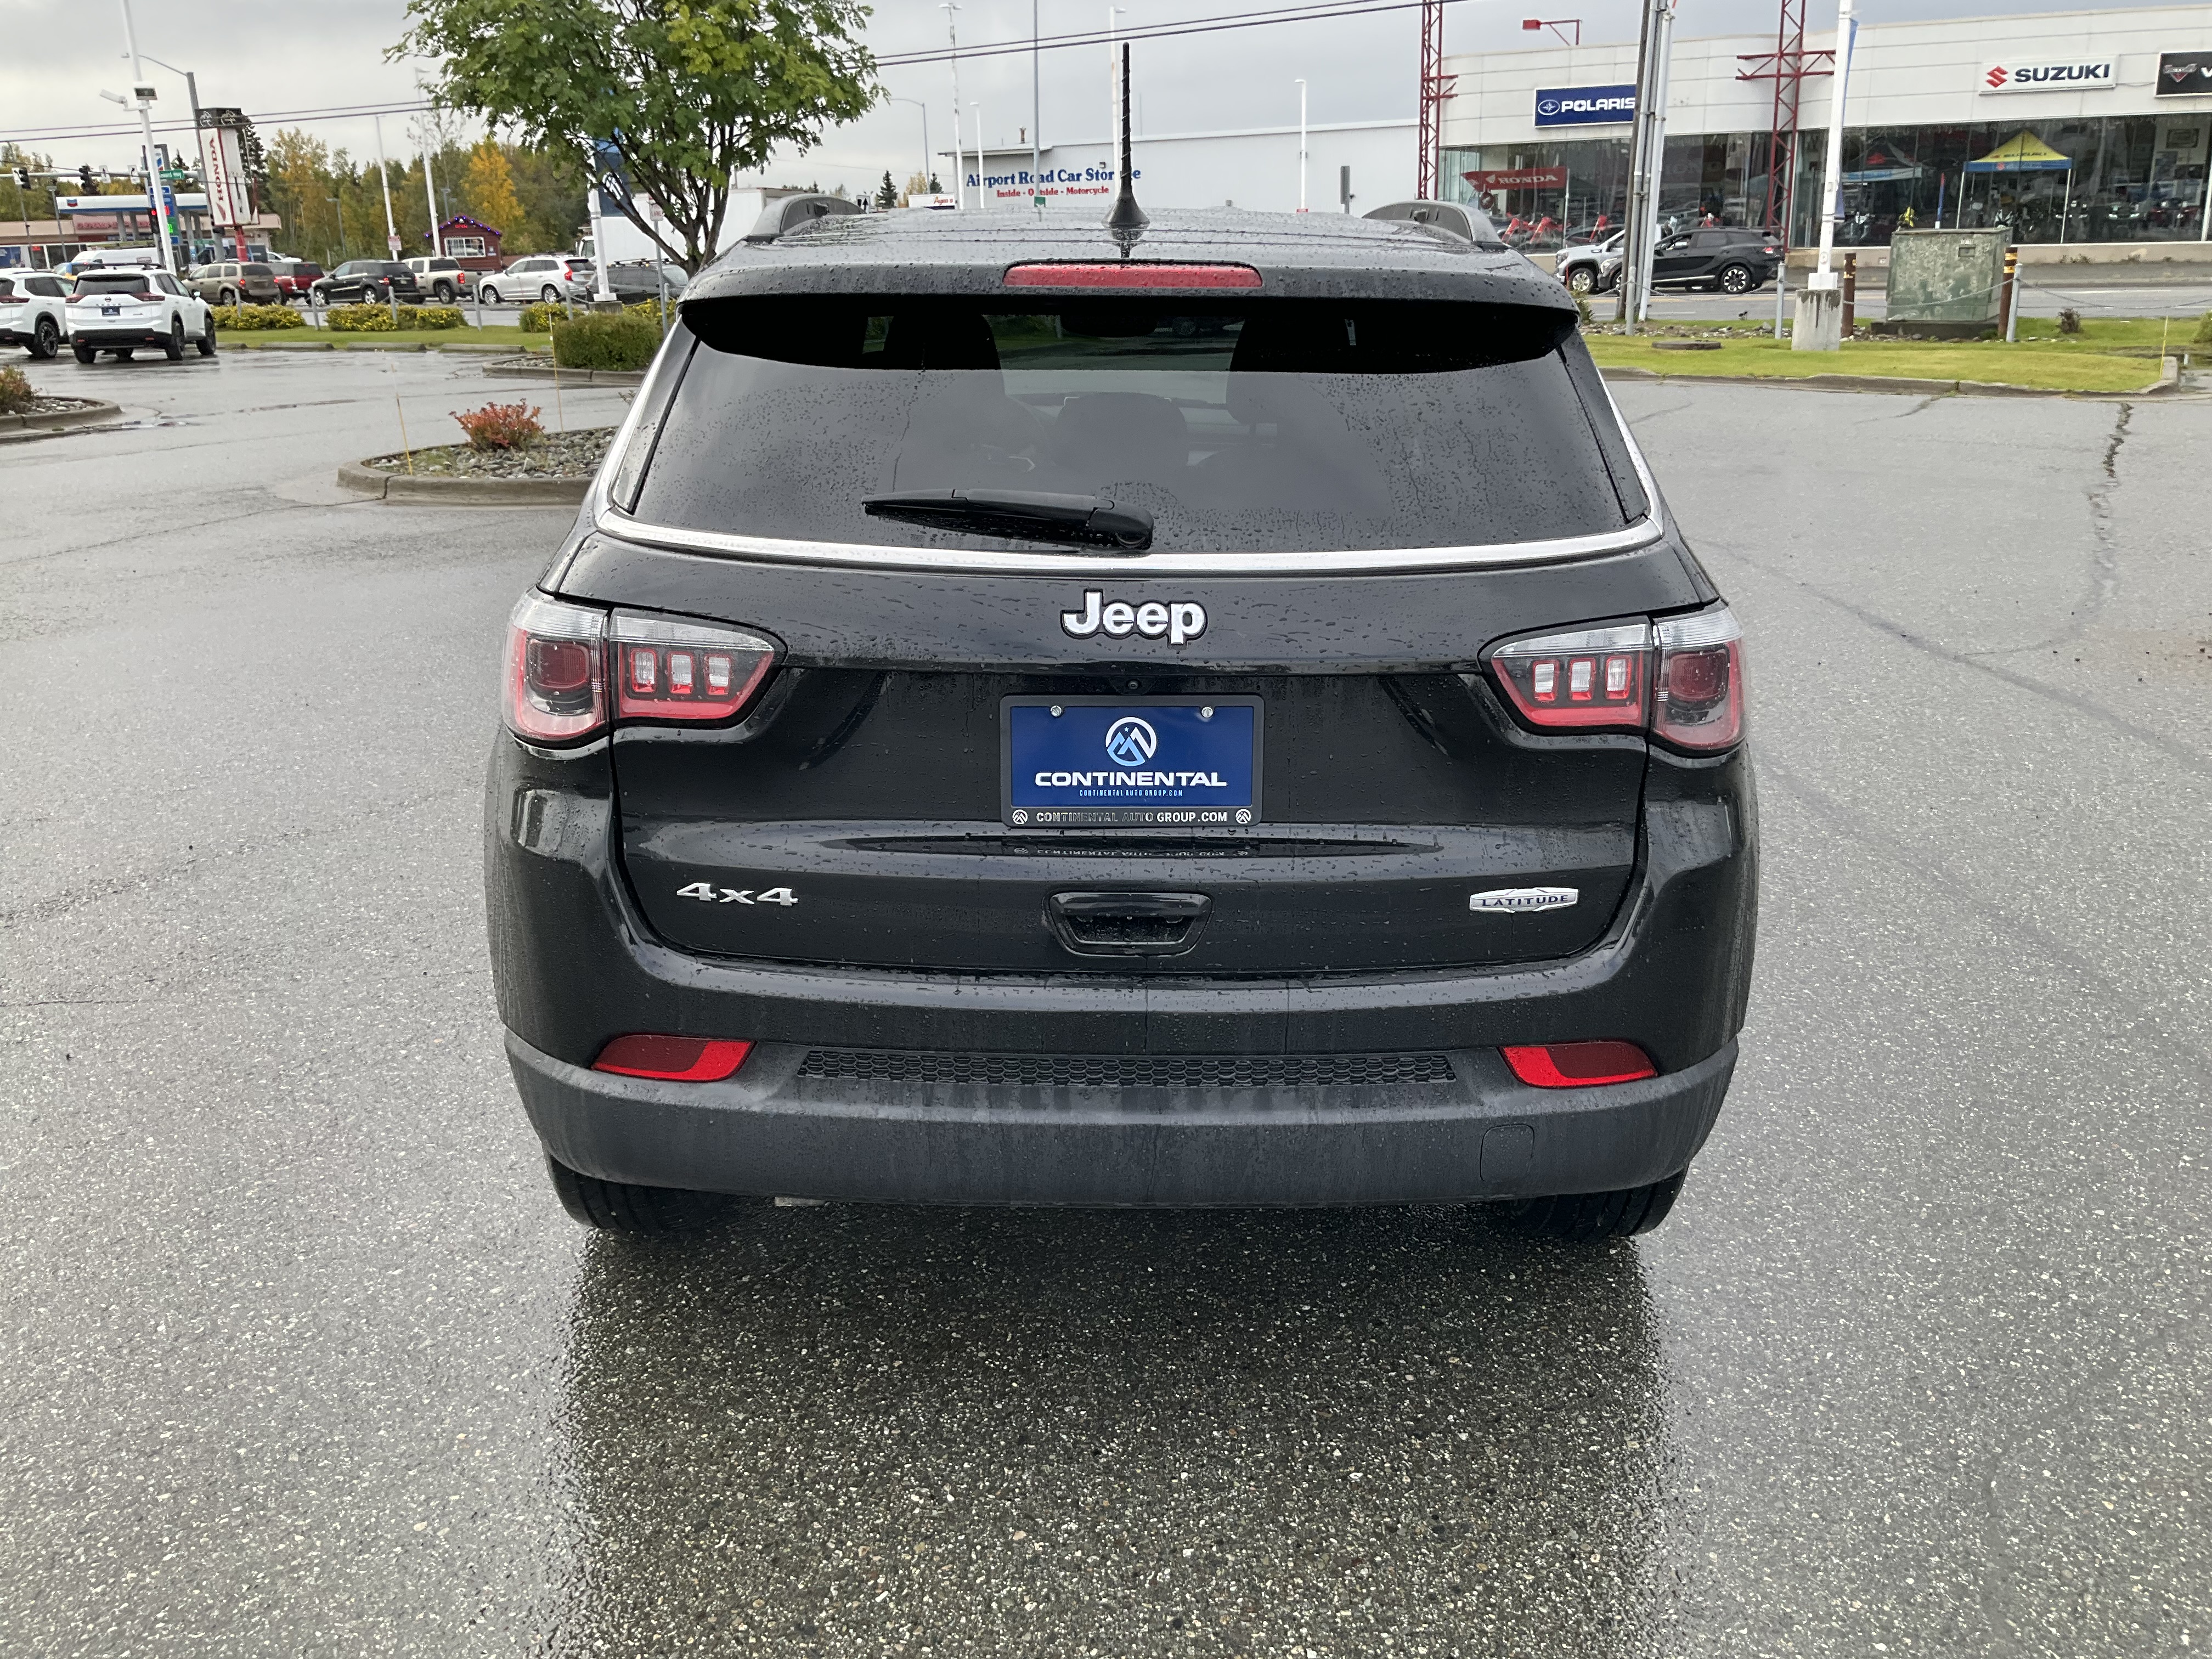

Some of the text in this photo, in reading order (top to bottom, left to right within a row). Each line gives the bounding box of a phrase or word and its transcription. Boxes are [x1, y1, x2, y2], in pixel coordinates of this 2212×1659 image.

[2015, 64, 2111, 82] SUZUKI
[1561, 97, 1636, 112] POLARIS
[210, 137, 224, 201] HONDA
[966, 173, 1015, 188] Airport
[1058, 169, 1082, 182] Car
[1085, 168, 1141, 182] Store
[1498, 174, 1559, 184] HONDA
[996, 186, 1109, 198] Inside Otside Motorcycle
[1063, 591, 1206, 645] Jeep
[1035, 772, 1227, 787] CONTINENTAL
[1036, 812, 1118, 822] CONTINENTAL
[1122, 812, 1154, 822] AUTO
[676, 882, 798, 906] 4x4
[1482, 895, 1569, 906] LATITUDE
